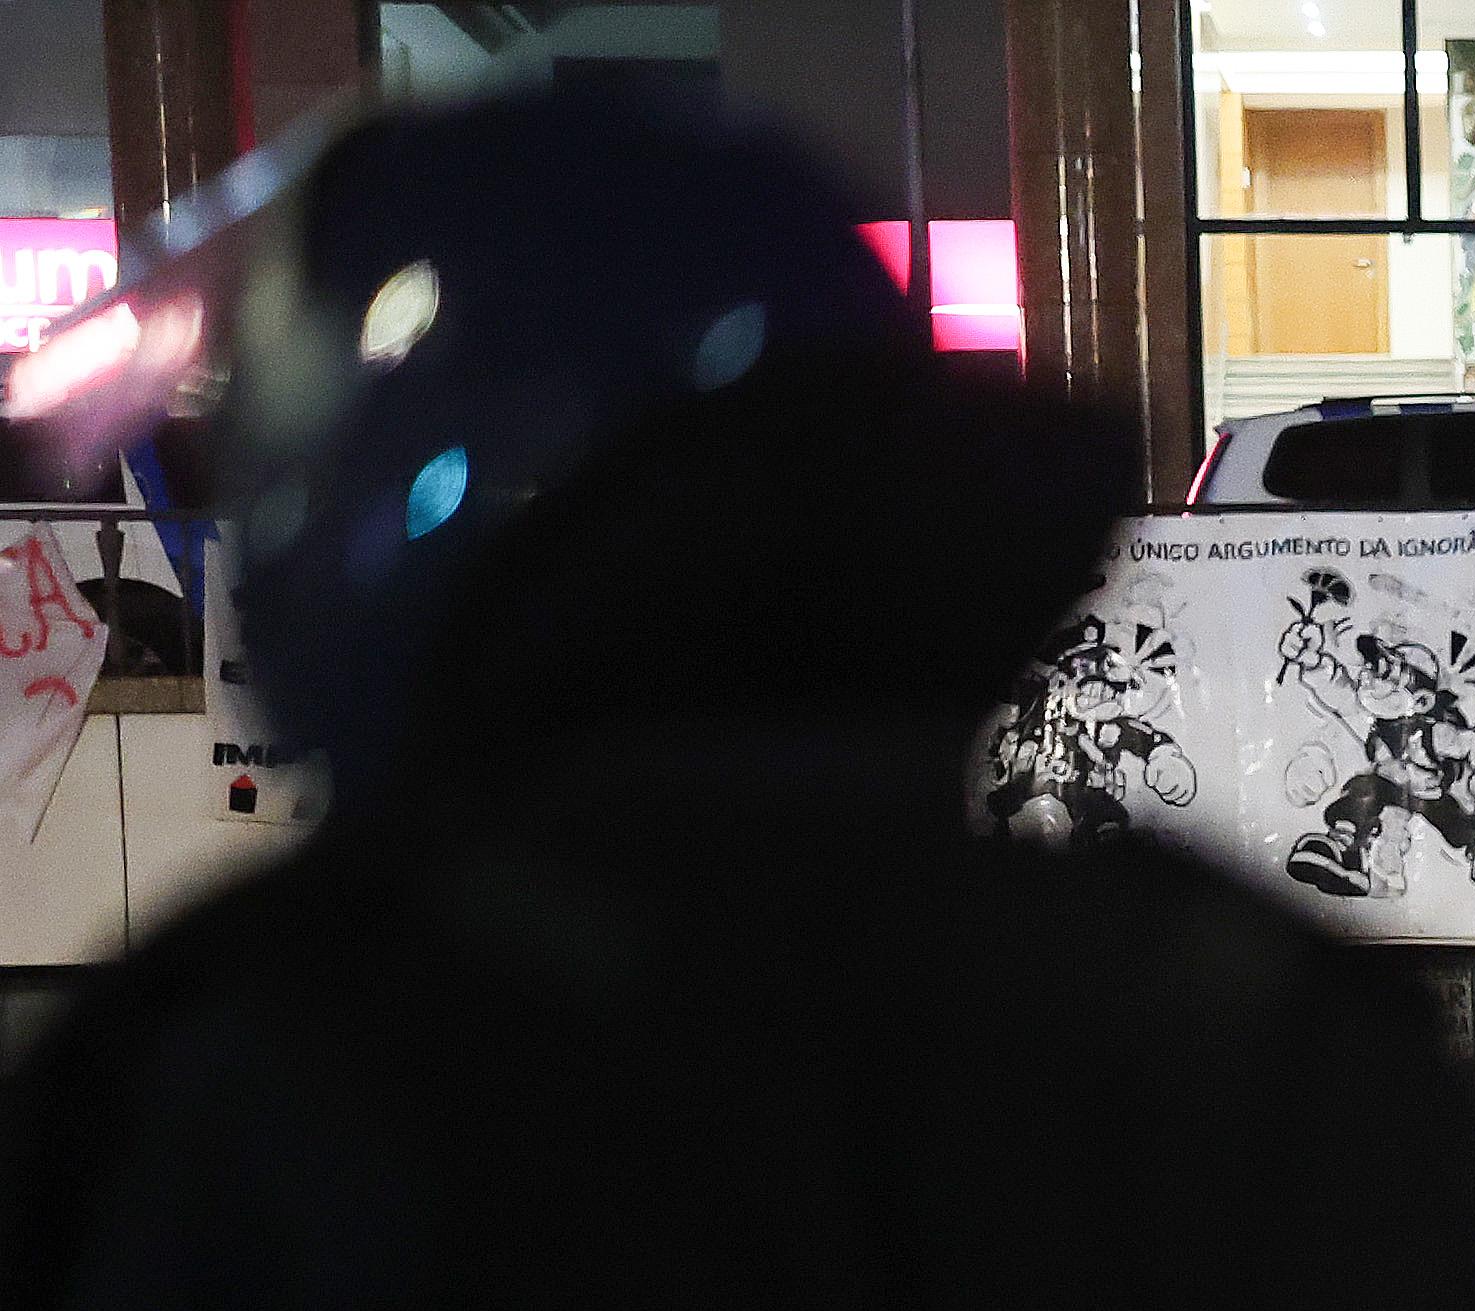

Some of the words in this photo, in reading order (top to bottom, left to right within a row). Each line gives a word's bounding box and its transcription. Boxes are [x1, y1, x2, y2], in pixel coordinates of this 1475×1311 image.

[1129, 537, 1199, 562] ÚNICO
[1207, 537, 1351, 561] ARGUMENTO
[1359, 538, 1394, 559] DA
